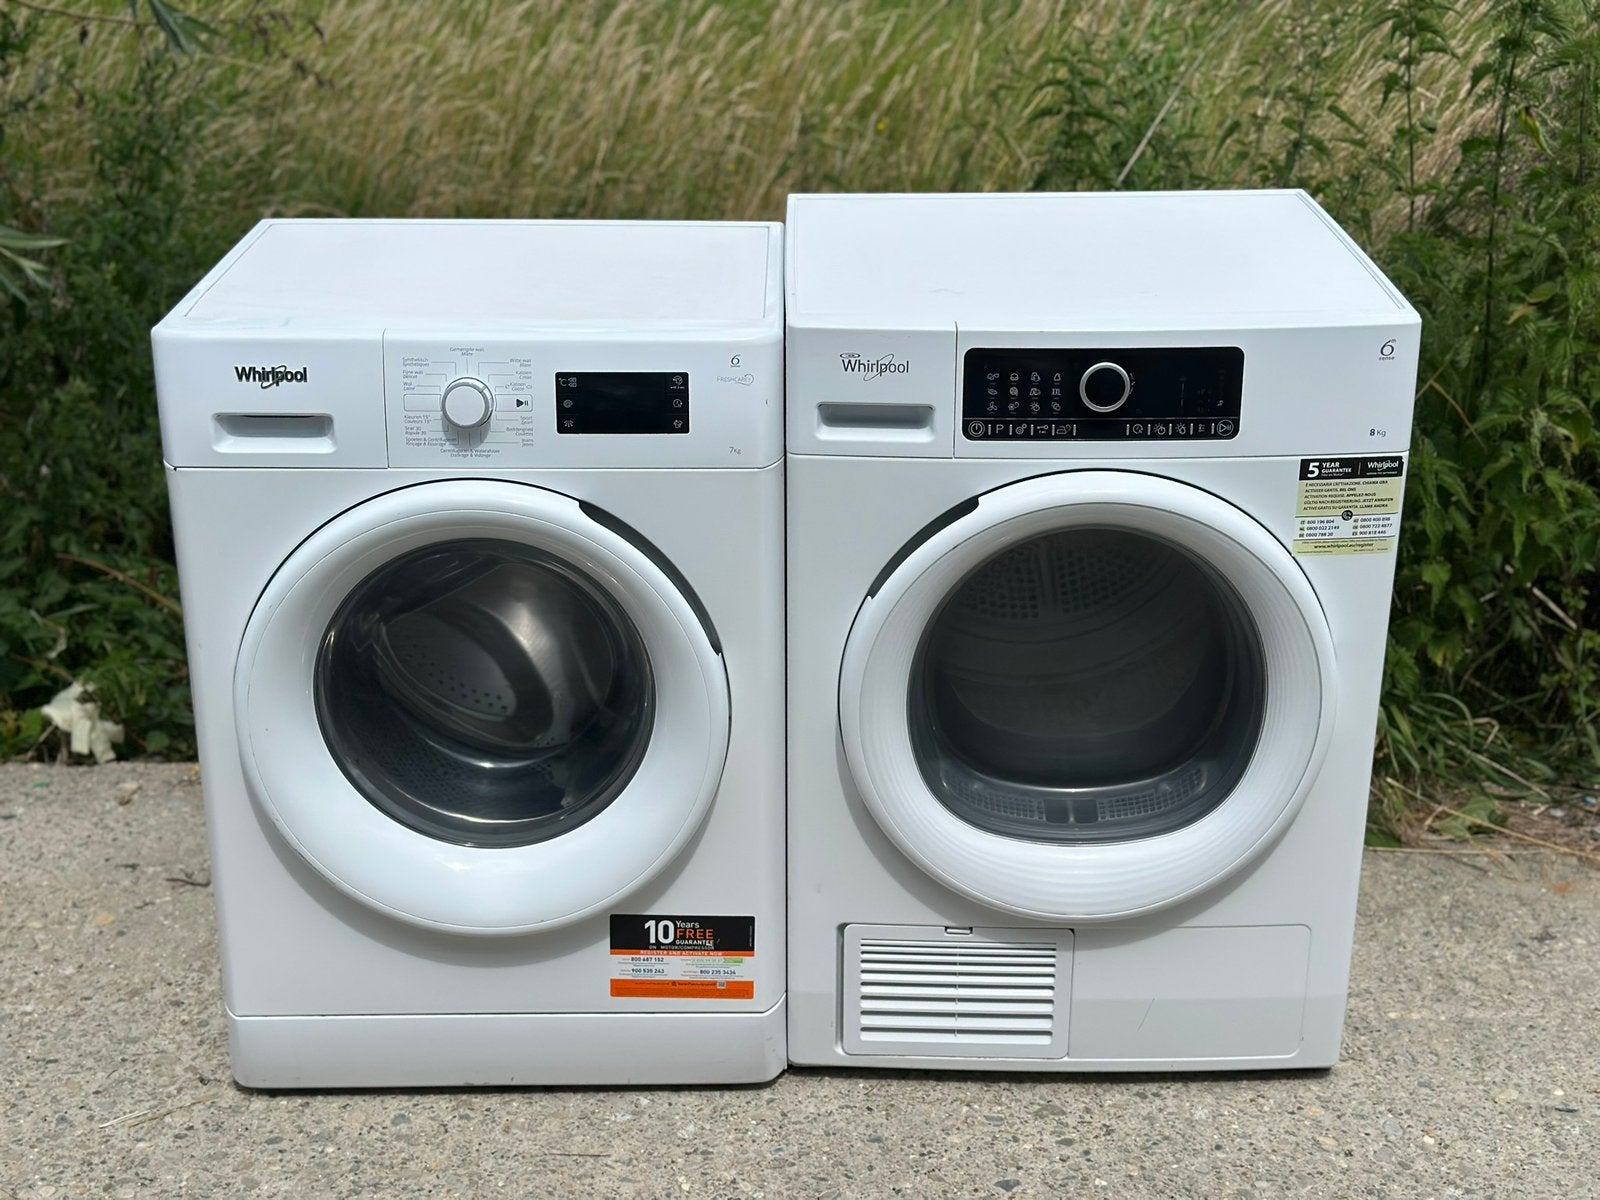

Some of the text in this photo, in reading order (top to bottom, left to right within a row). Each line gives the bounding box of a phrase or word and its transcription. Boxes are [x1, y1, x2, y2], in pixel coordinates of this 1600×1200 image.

[730, 354, 741, 365] 6
[842, 356, 909, 379] Whirlpool
[234, 365, 308, 388] Whirlpool
[996, 424, 1004, 434] P
[1369, 428, 1386, 437] 8 Kg
[1307, 462, 1320, 477] 5
[1367, 460, 1398, 471] Whirlpool
[644, 920, 674, 944] 10
[676, 929, 714, 939] FREE
